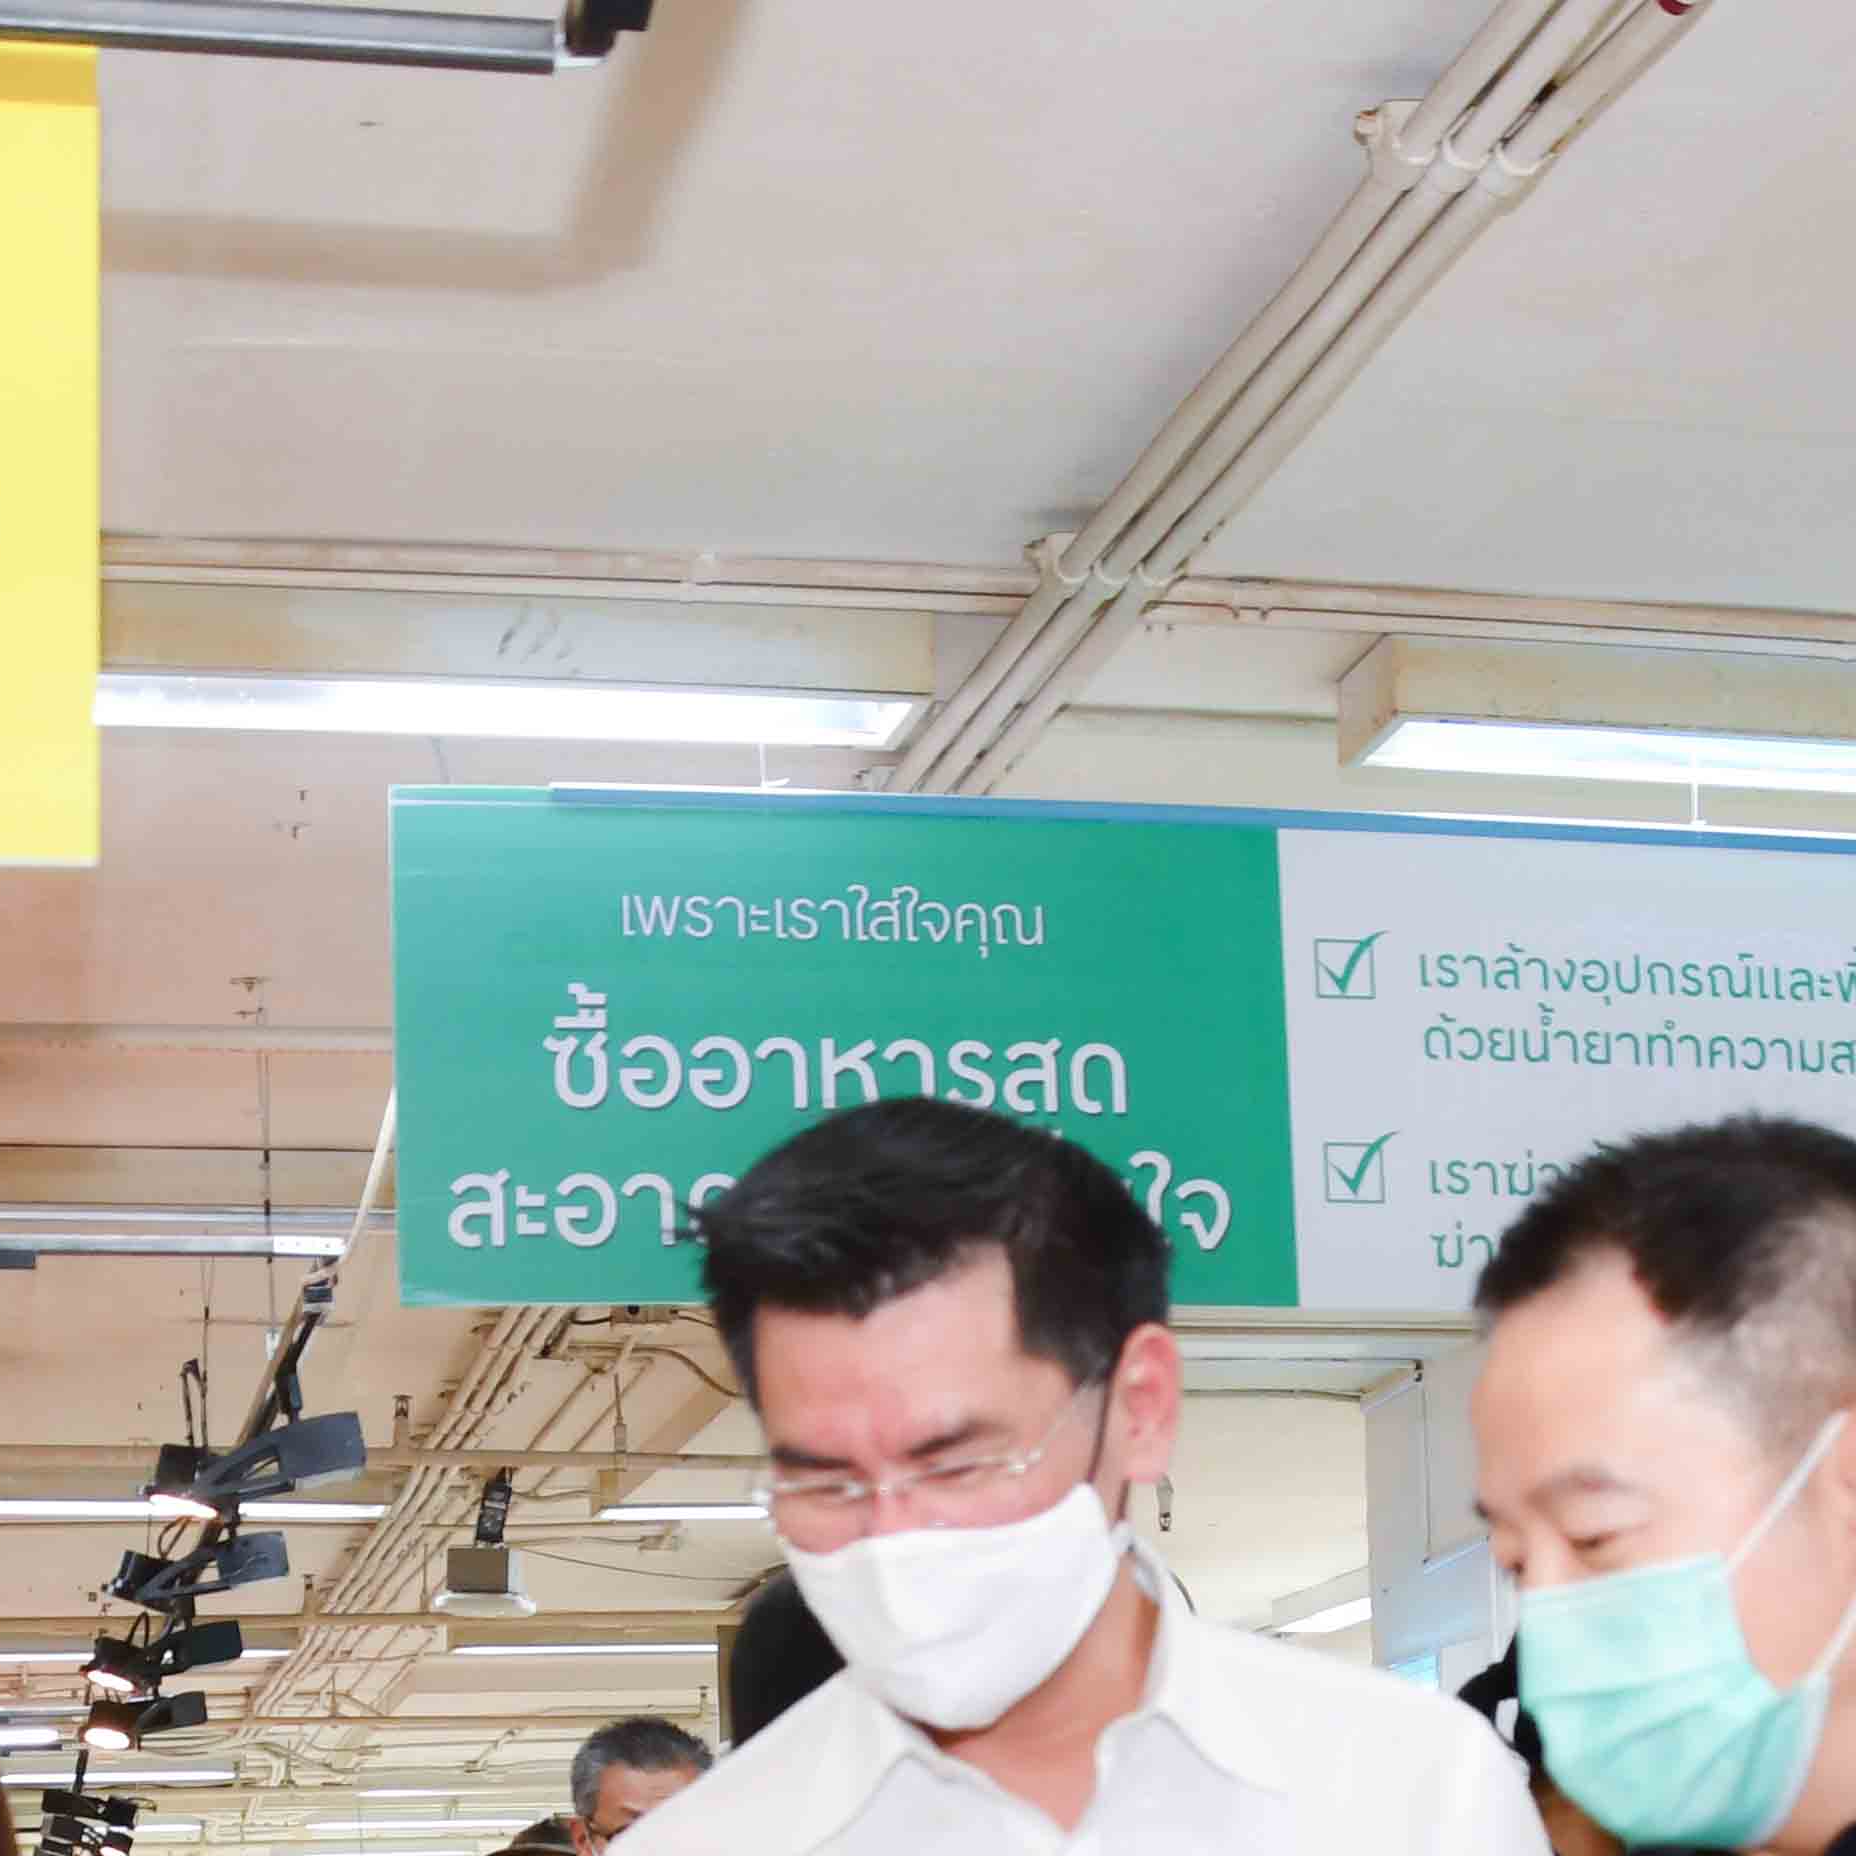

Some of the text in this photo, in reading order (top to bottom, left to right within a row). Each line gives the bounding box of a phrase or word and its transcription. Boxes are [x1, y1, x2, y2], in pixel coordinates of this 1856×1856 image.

[621, 885, 1046, 958] เพราะเราใส่ใจคุณ
[543, 982, 1130, 1116] ซื้ออาหารสด
